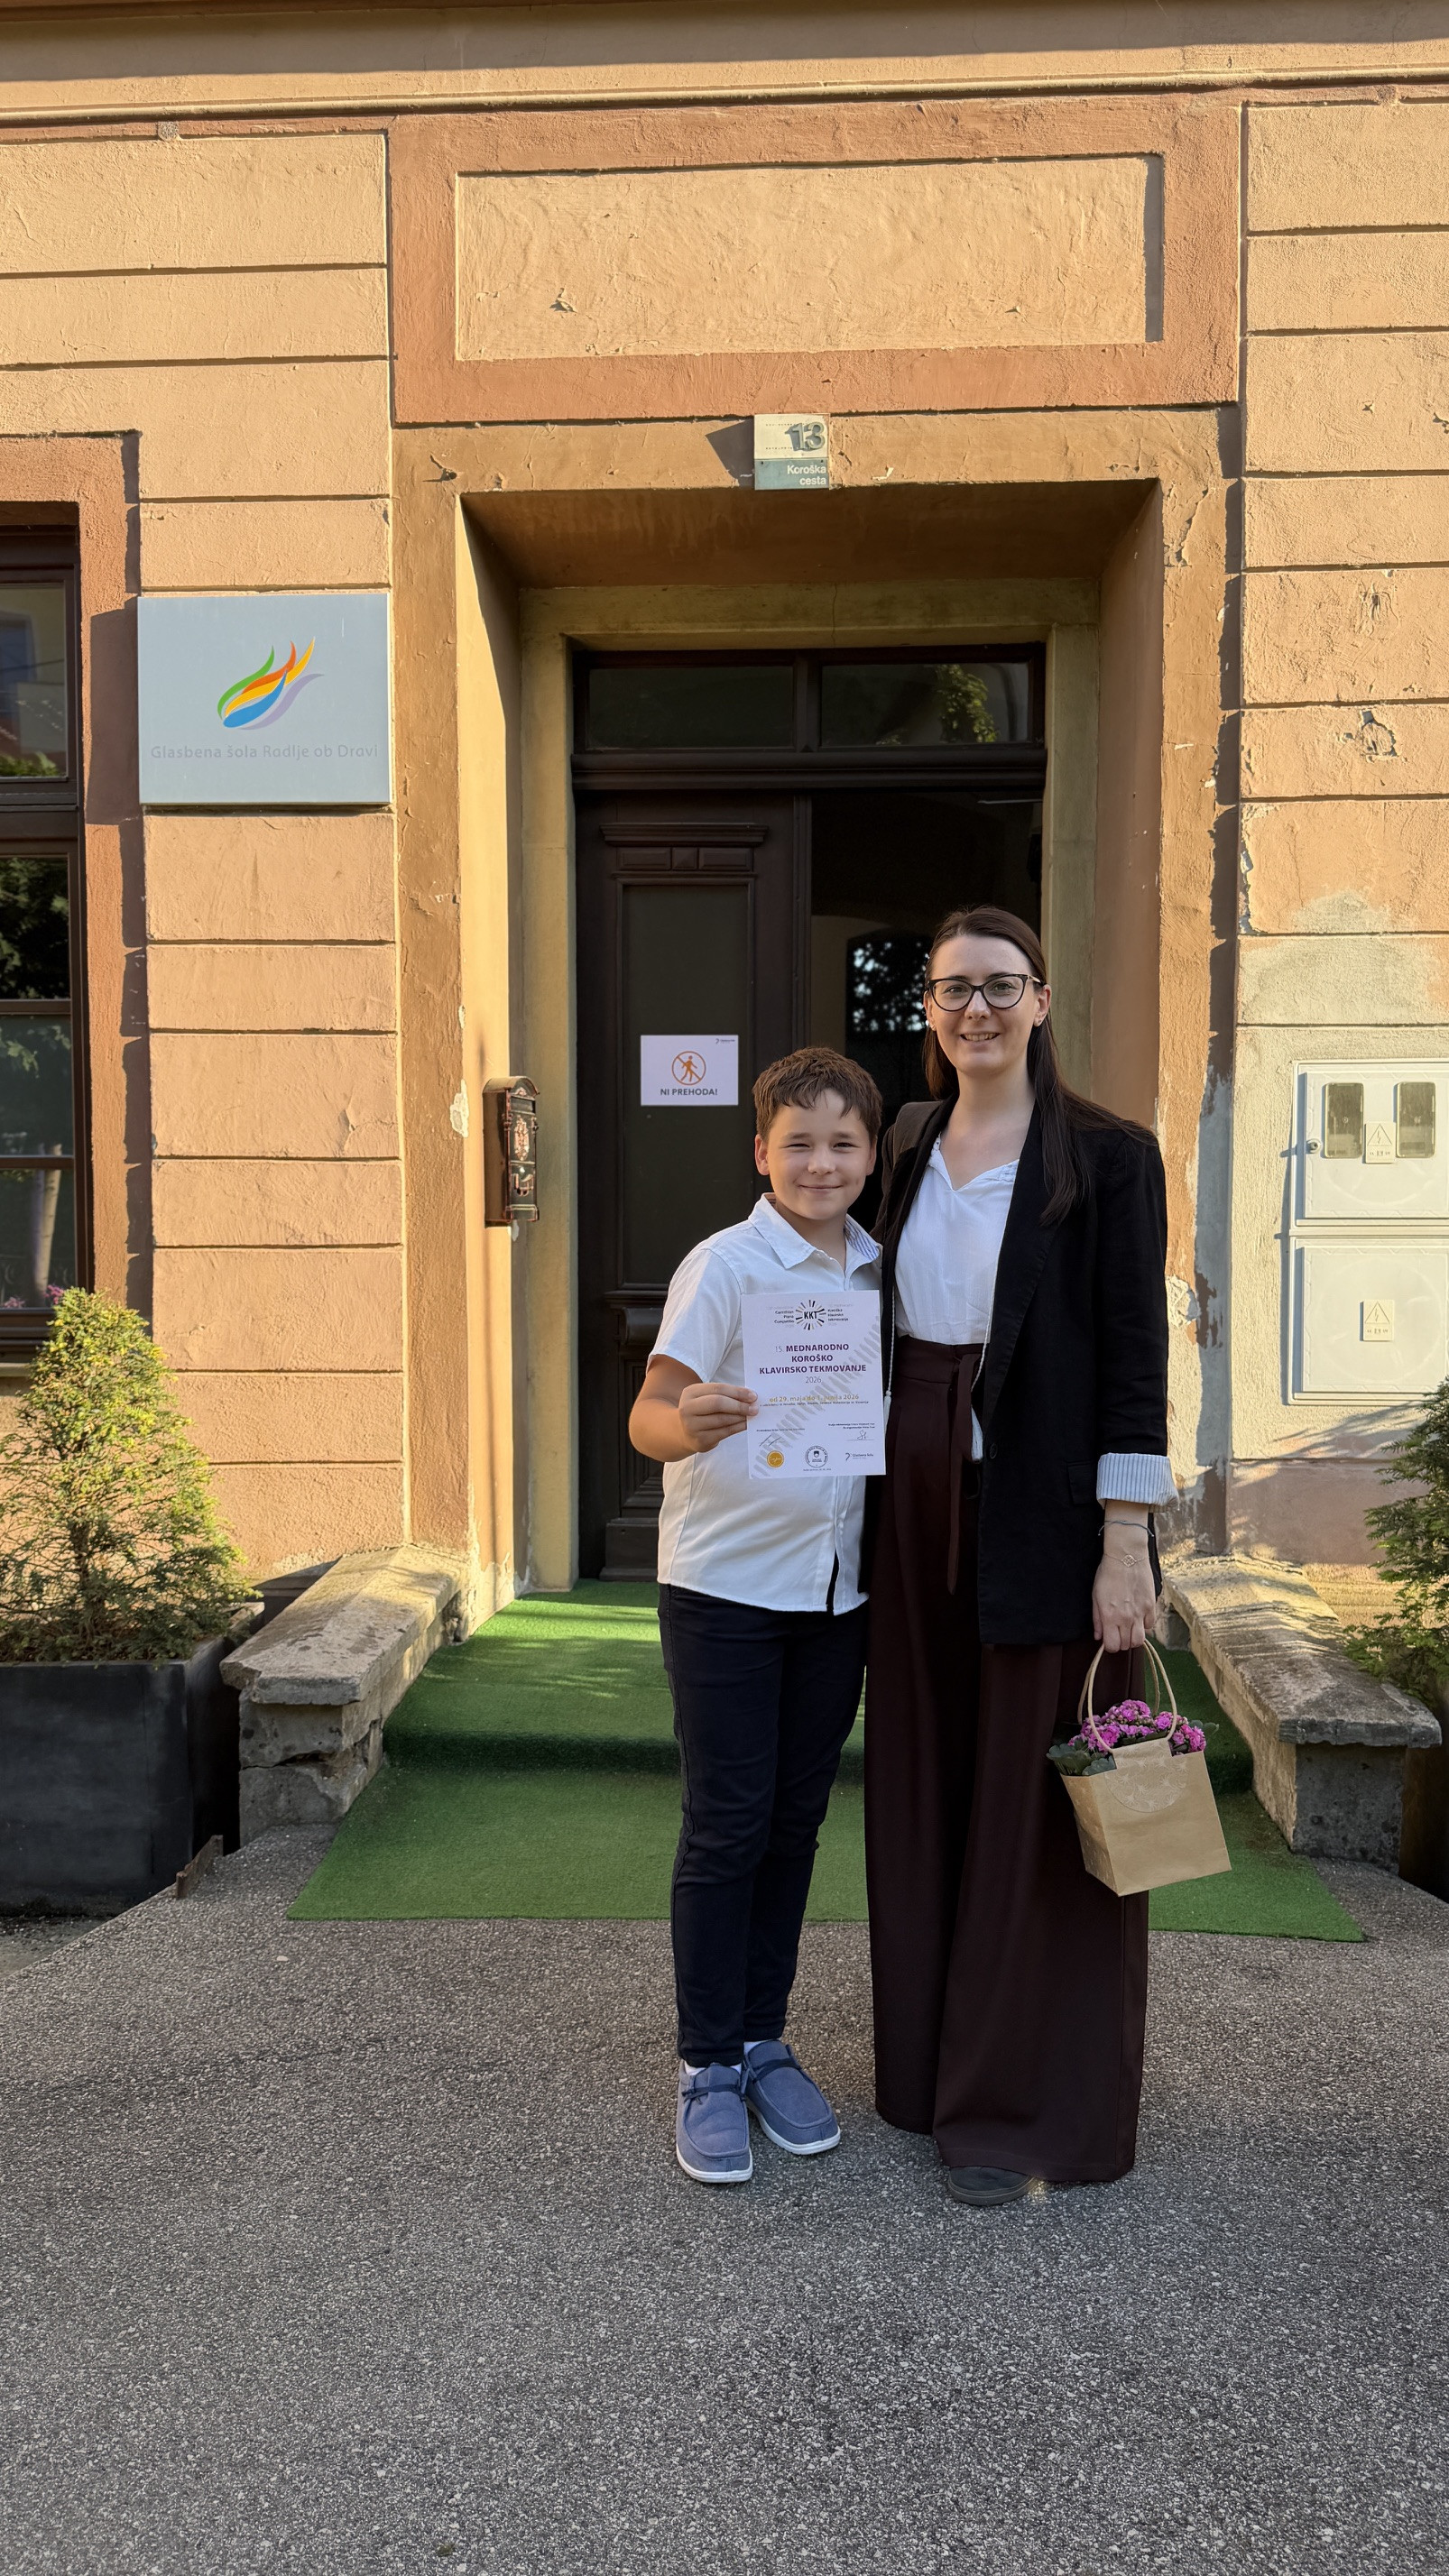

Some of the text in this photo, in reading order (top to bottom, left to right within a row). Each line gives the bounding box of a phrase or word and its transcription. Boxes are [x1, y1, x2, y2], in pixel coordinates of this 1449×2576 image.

[791, 422, 825, 449] 13
[787, 465, 826, 474] Koroška
[799, 476, 826, 485] cesta
[151, 745, 378, 761] Glasbena šola Radlje ob Dravi
[804, 1311, 818, 1319] KKT
[786, 1343, 849, 1352] MEDNARODNO
[792, 1354, 833, 1362] KOROŠKO
[759, 1364, 866, 1374] KLAVIRSKO TEKMOVANJE
